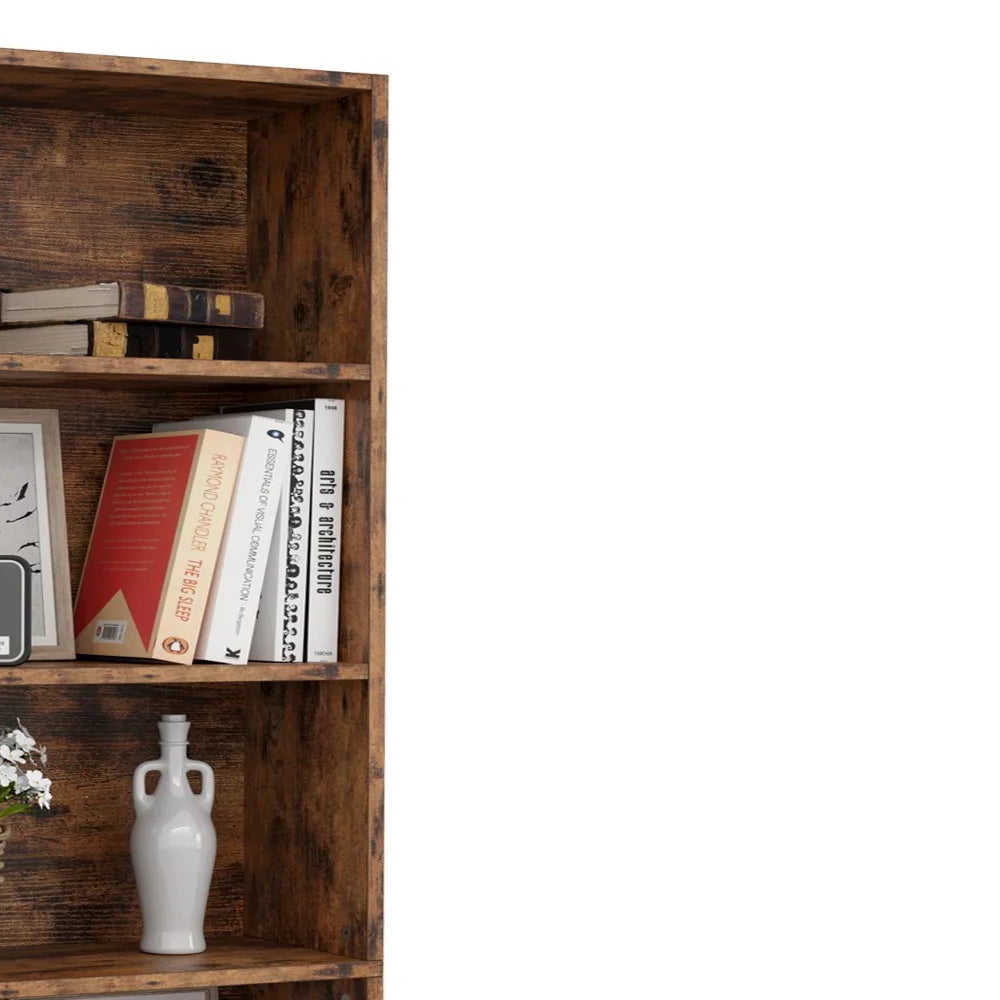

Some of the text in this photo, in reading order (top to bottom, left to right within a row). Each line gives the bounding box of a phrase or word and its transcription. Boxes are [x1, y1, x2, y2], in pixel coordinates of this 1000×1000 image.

[191, 453, 227, 552] RAYMOND CHANDLER
[319, 469, 338, 495] arts
[239, 535, 261, 602] COMMUNICATION
[316, 516, 337, 595] architecture
[174, 560, 202, 622] THE BIG SLEEP
